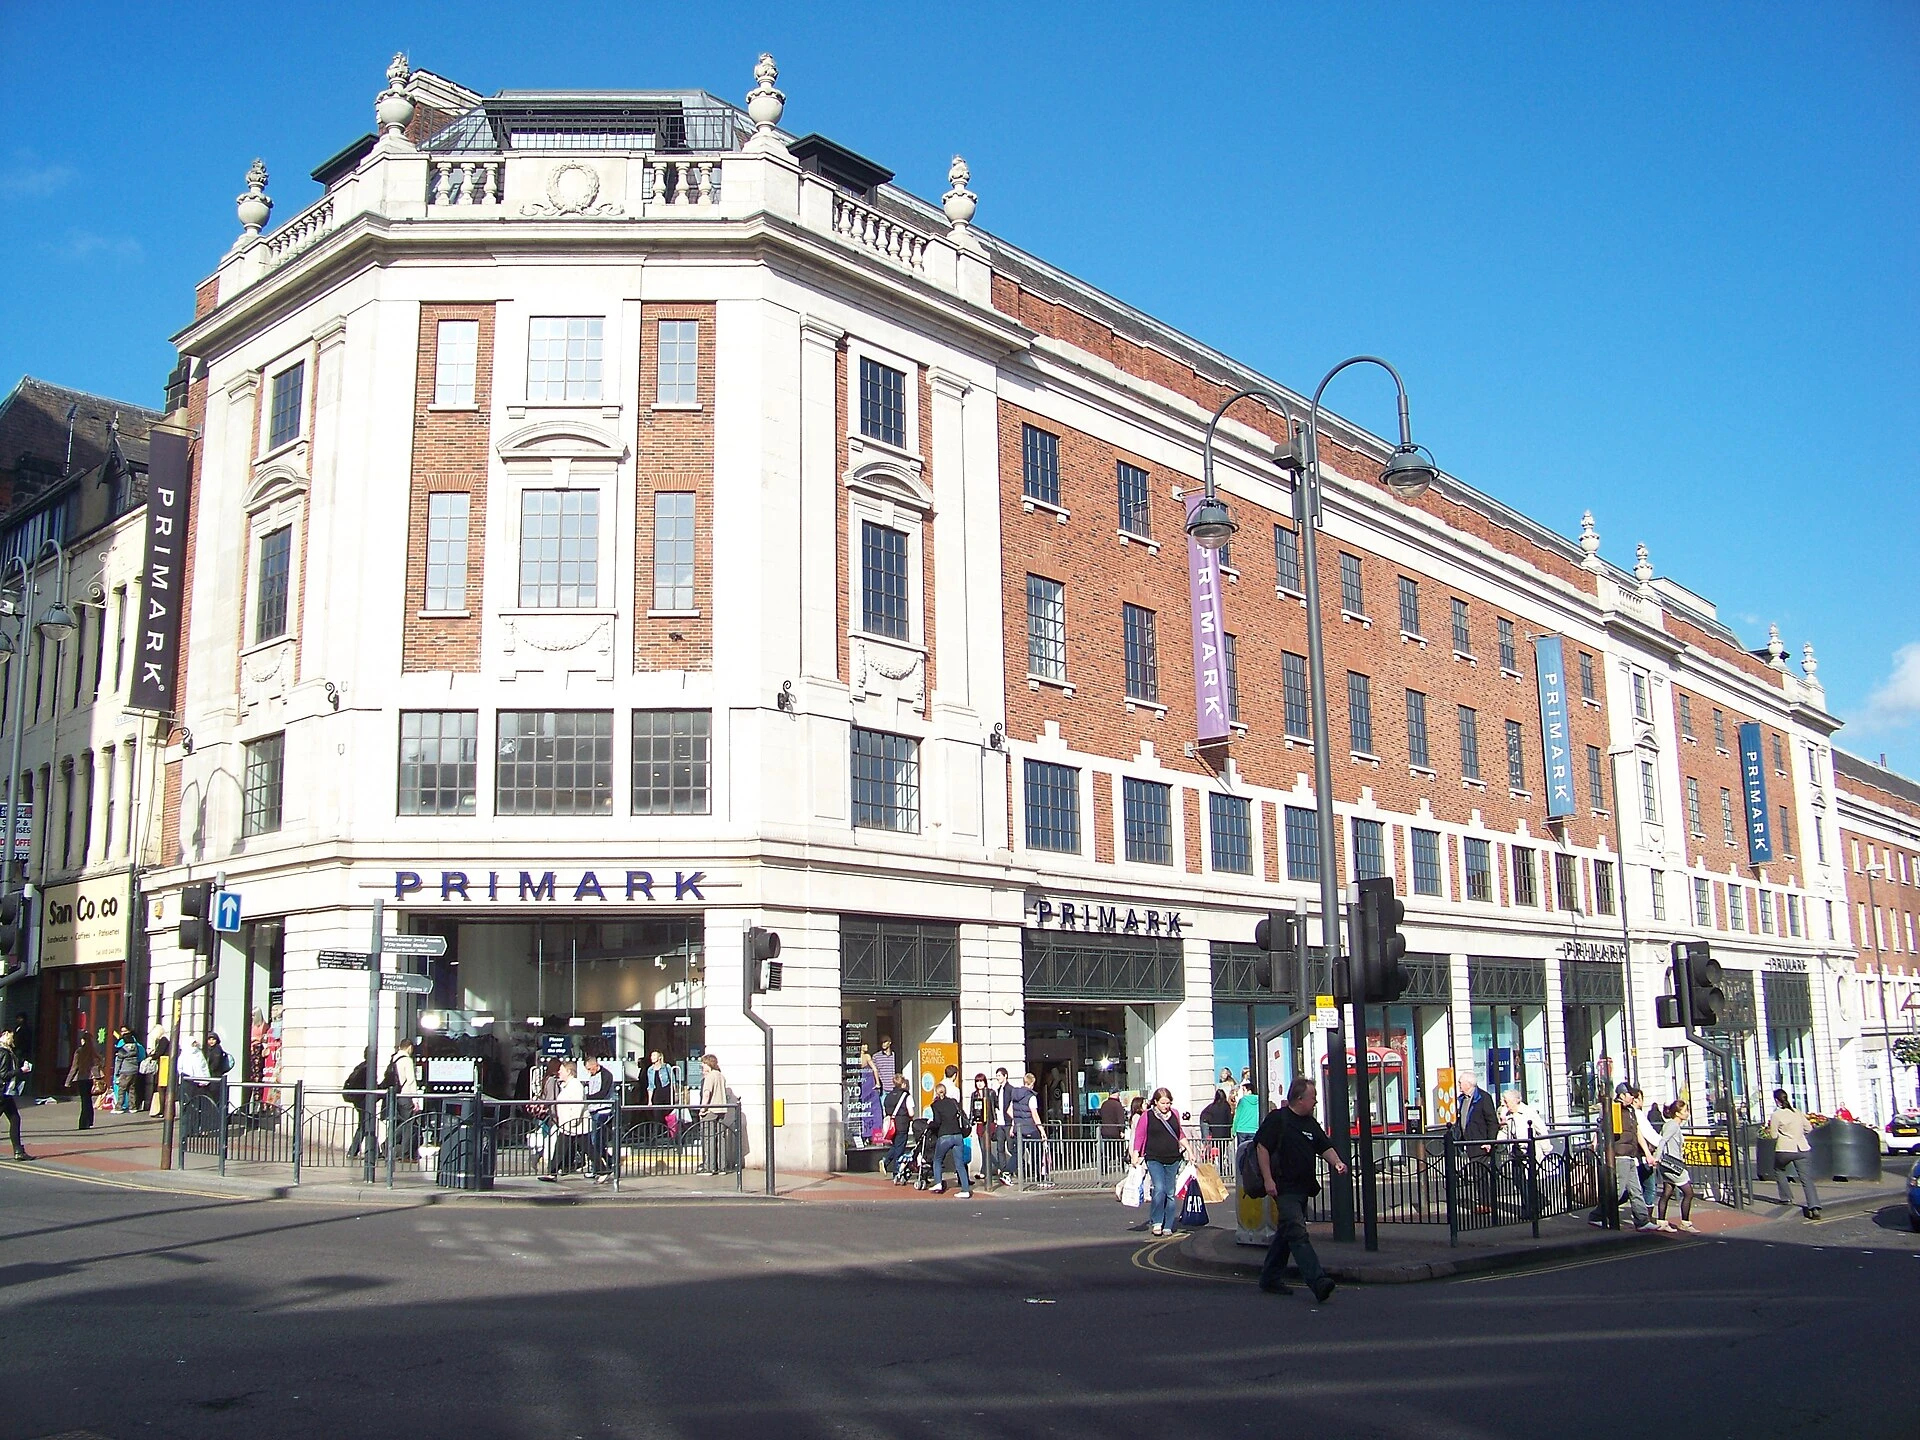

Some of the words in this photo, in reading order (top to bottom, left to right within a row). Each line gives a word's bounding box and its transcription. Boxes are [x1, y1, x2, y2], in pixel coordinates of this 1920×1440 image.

[143, 487, 174, 686] PRIMARK
[1197, 544, 1220, 716] PRIMARK
[1545, 672, 1567, 800] PRIMARK
[1747, 751, 1766, 850] PRIMARK
[395, 871, 706, 901] PRIMARK
[49, 900, 73, 926] San
[1036, 900, 1182, 934] PRIMARK
[1563, 942, 1627, 959] PRIMARK
[921, 1047, 942, 1056] SPRING
[921, 1056, 945, 1065] SAVINGS
[847, 1102, 872, 1111] girl2girl
[1186, 1195, 1203, 1213] GAP
